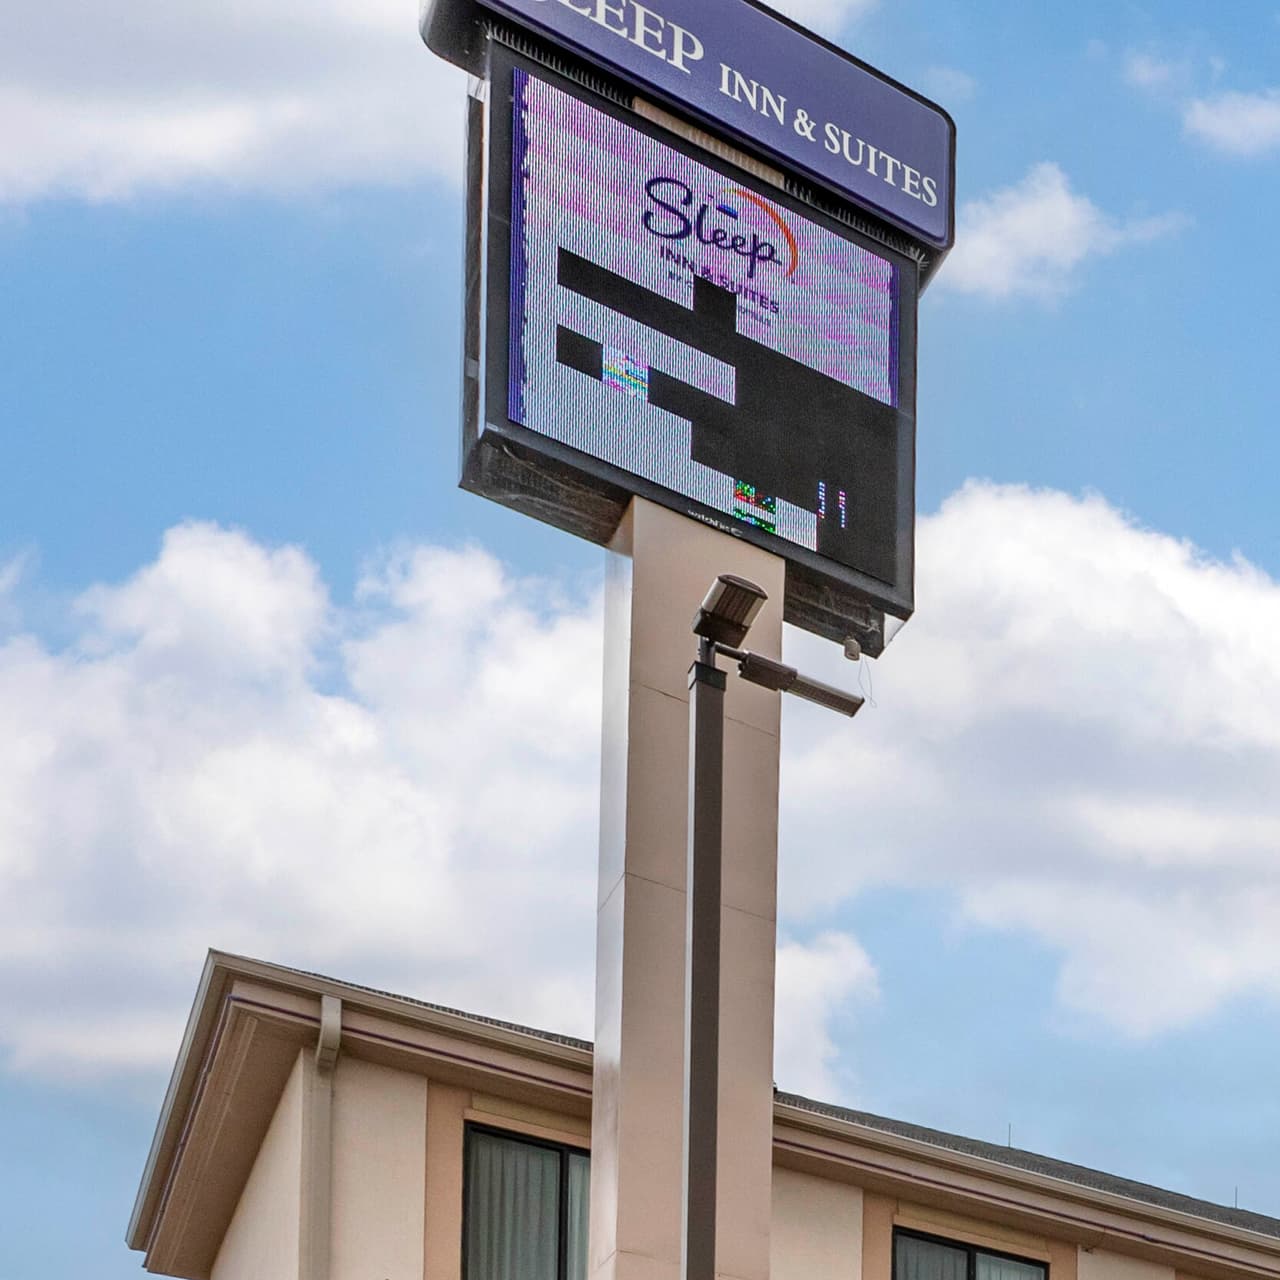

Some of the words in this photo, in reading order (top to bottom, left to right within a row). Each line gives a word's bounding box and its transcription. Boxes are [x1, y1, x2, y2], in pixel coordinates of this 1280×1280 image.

[535, 0, 705, 75] EEP
[719, 63, 787, 125] INN
[793, 108, 817, 142] &
[824, 122, 938, 207] SUITES
[643, 177, 782, 278] Sleep
